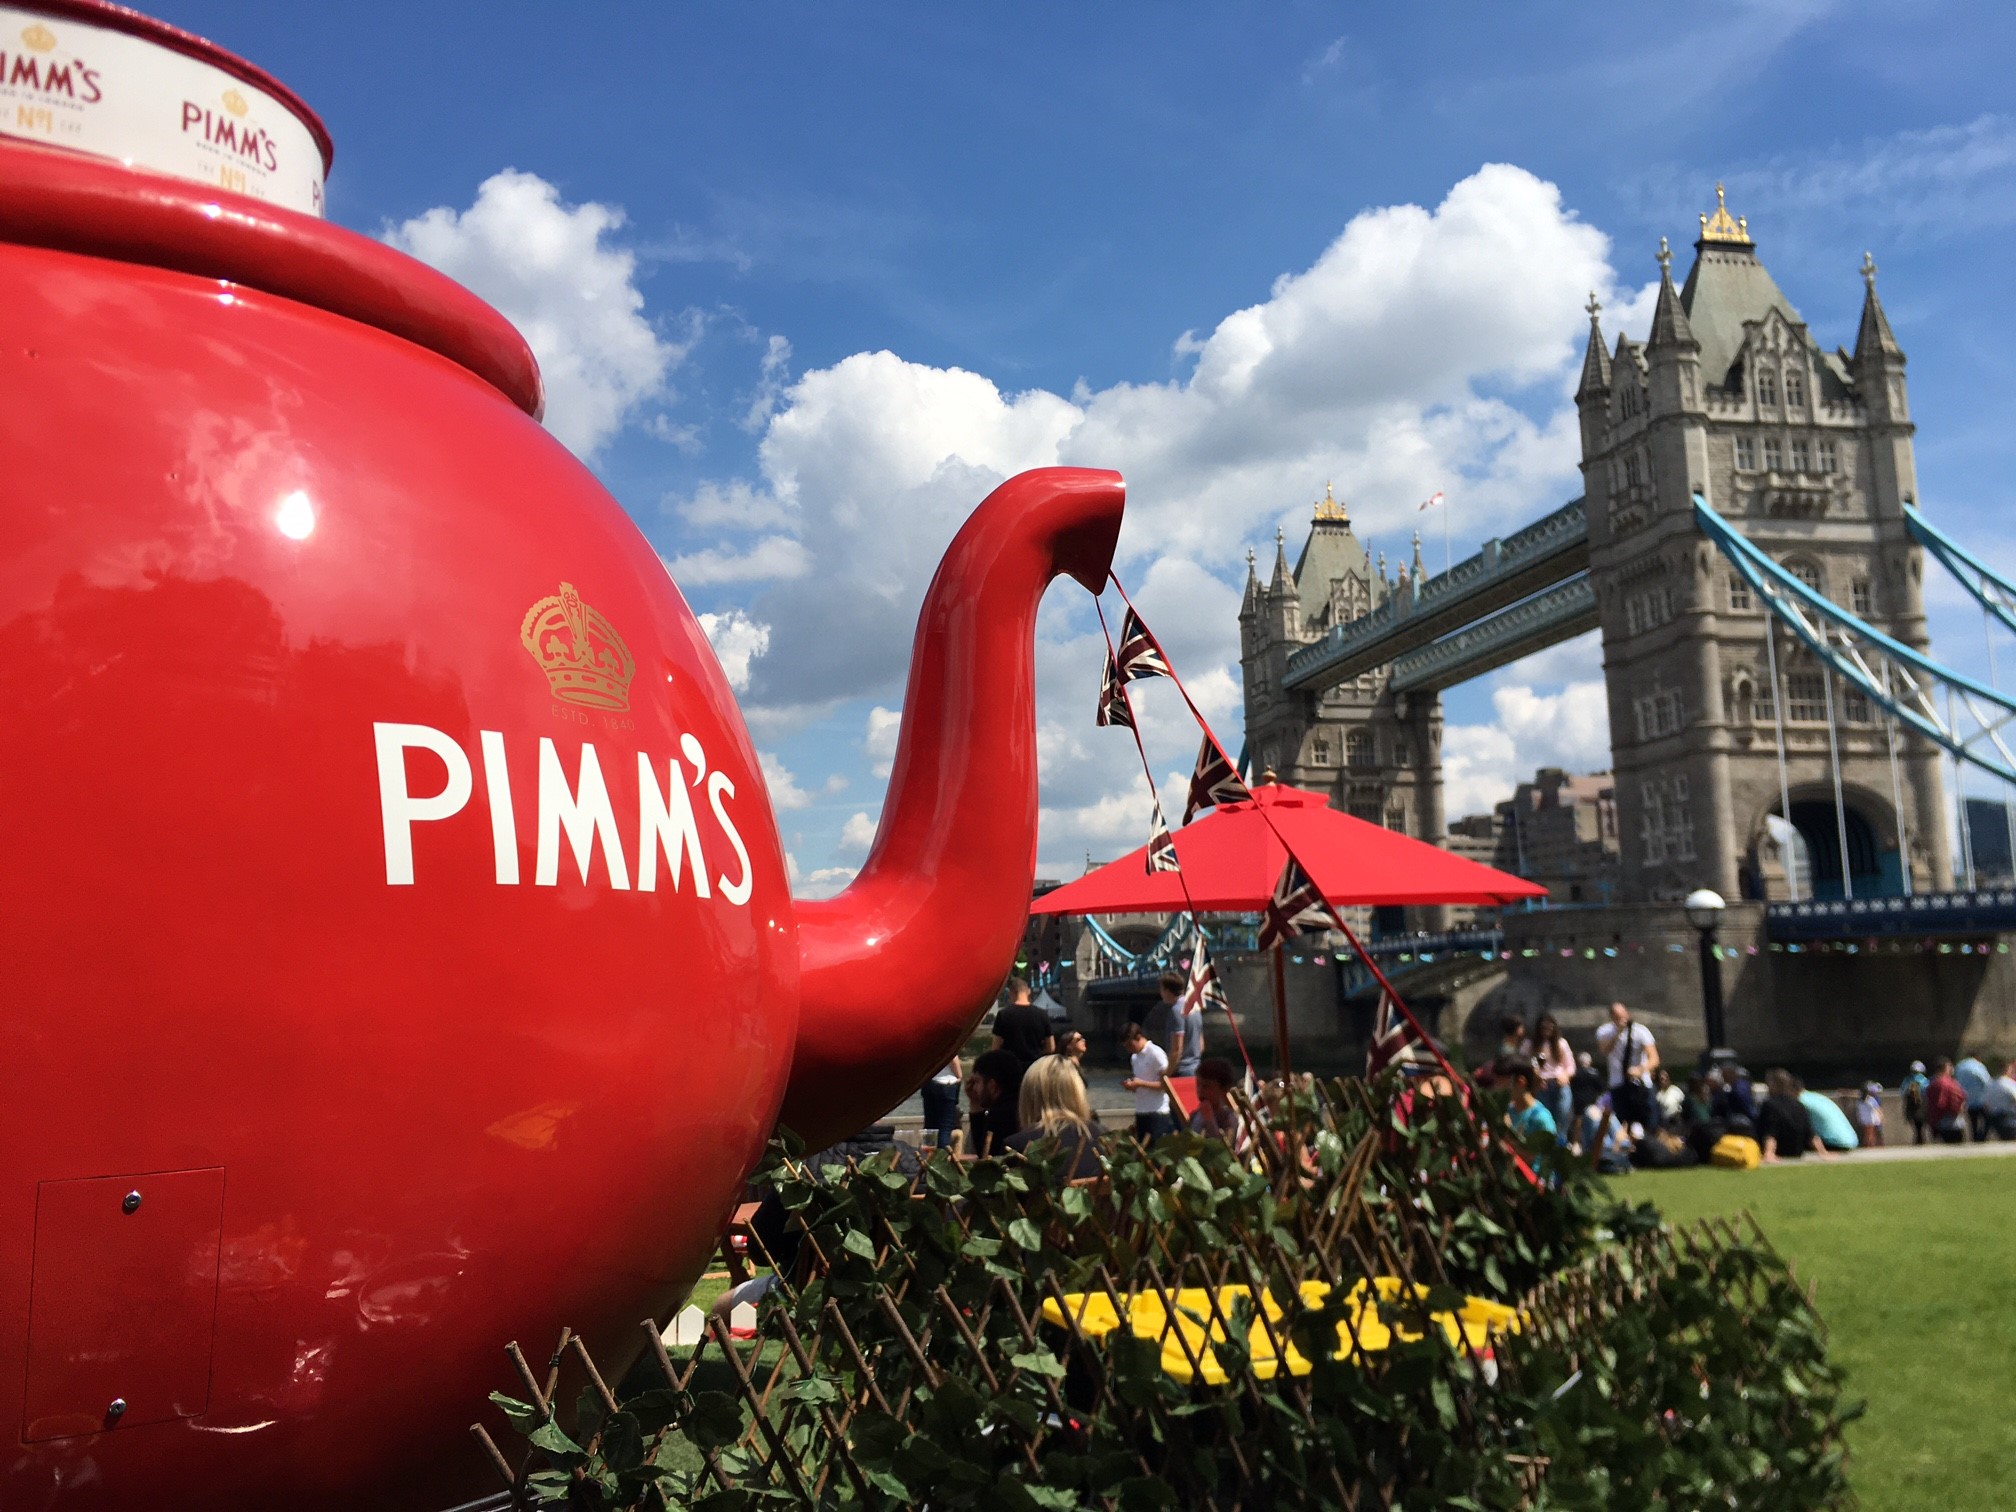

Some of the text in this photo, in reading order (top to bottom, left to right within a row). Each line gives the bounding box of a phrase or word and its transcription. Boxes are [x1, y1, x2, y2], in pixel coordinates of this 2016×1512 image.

[0, 50, 102, 104] IMM'S
[181, 100, 277, 172] PIMM'S
[552, 704, 635, 732] ESTD. 1840
[373, 721, 753, 906] PIMM'S
